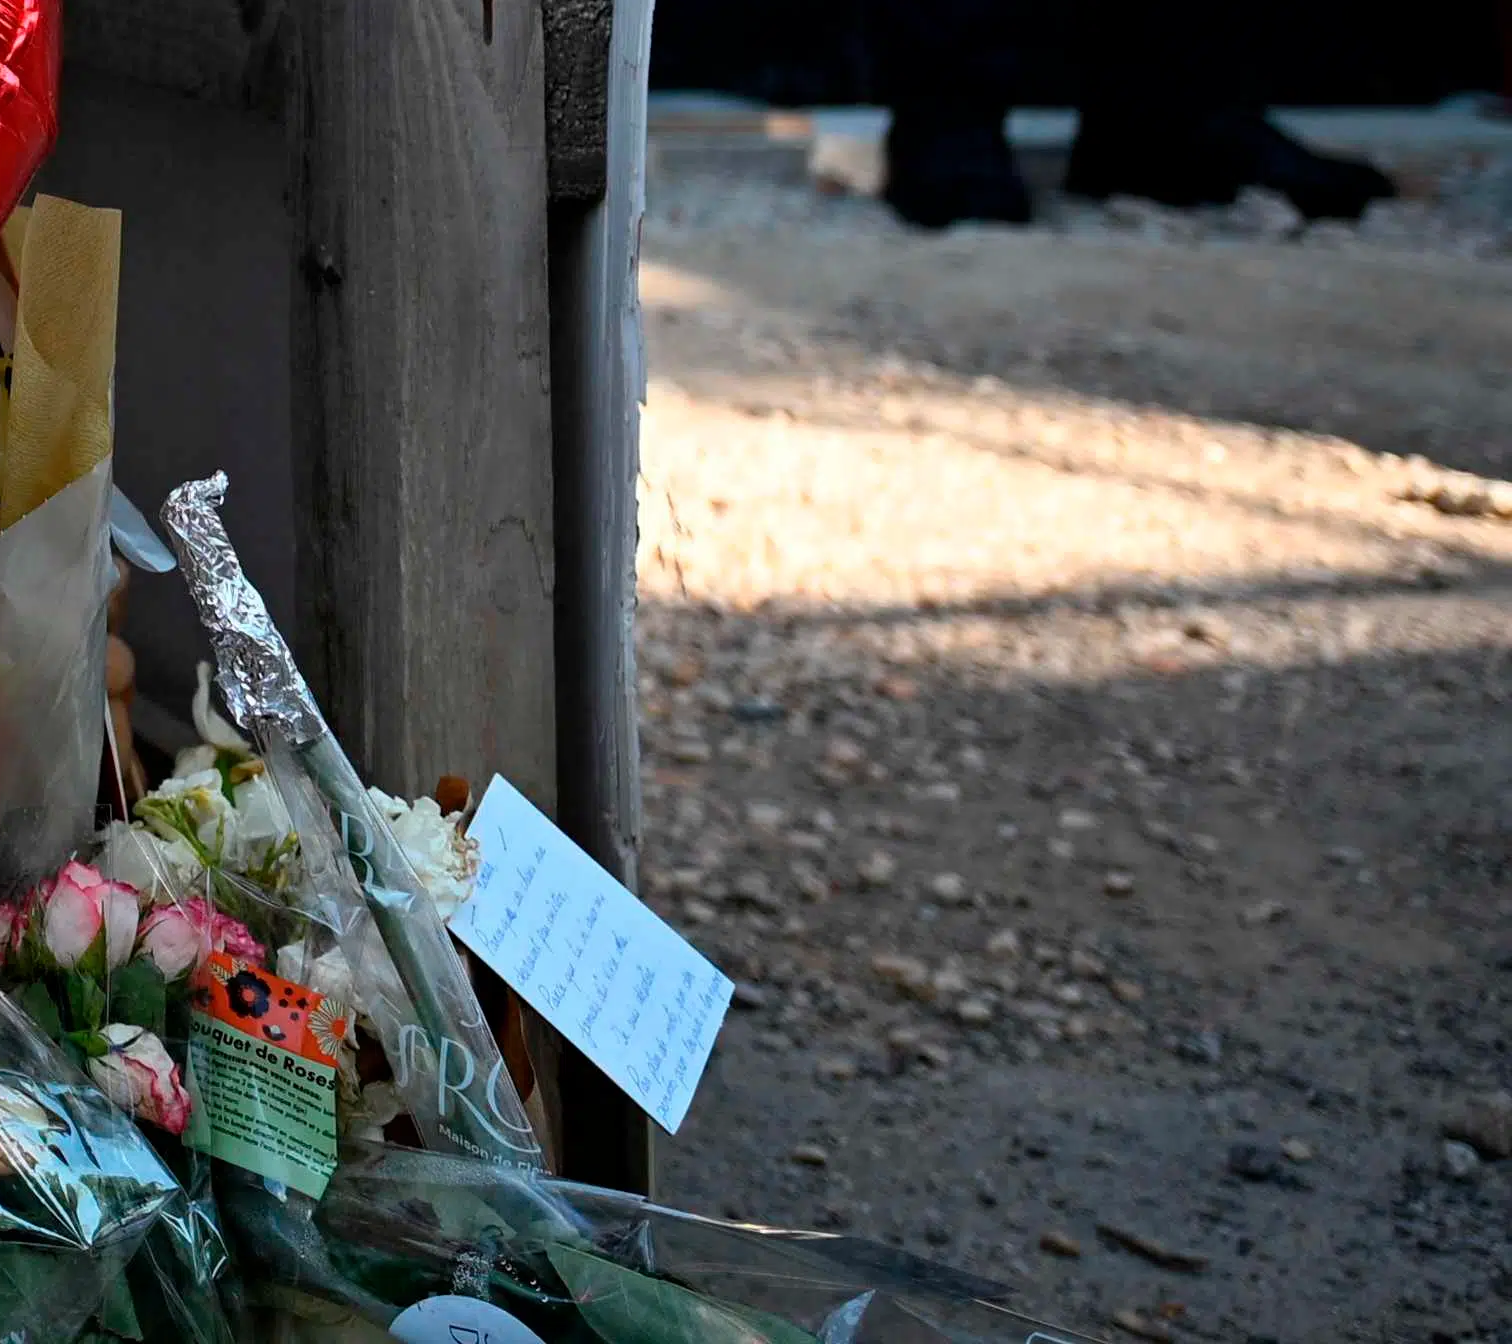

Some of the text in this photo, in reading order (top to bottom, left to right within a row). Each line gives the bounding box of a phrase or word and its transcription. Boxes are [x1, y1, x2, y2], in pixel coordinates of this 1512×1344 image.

[191, 1021, 336, 1092] ouquet de Roses
[438, 1123, 490, 1161] Maison
